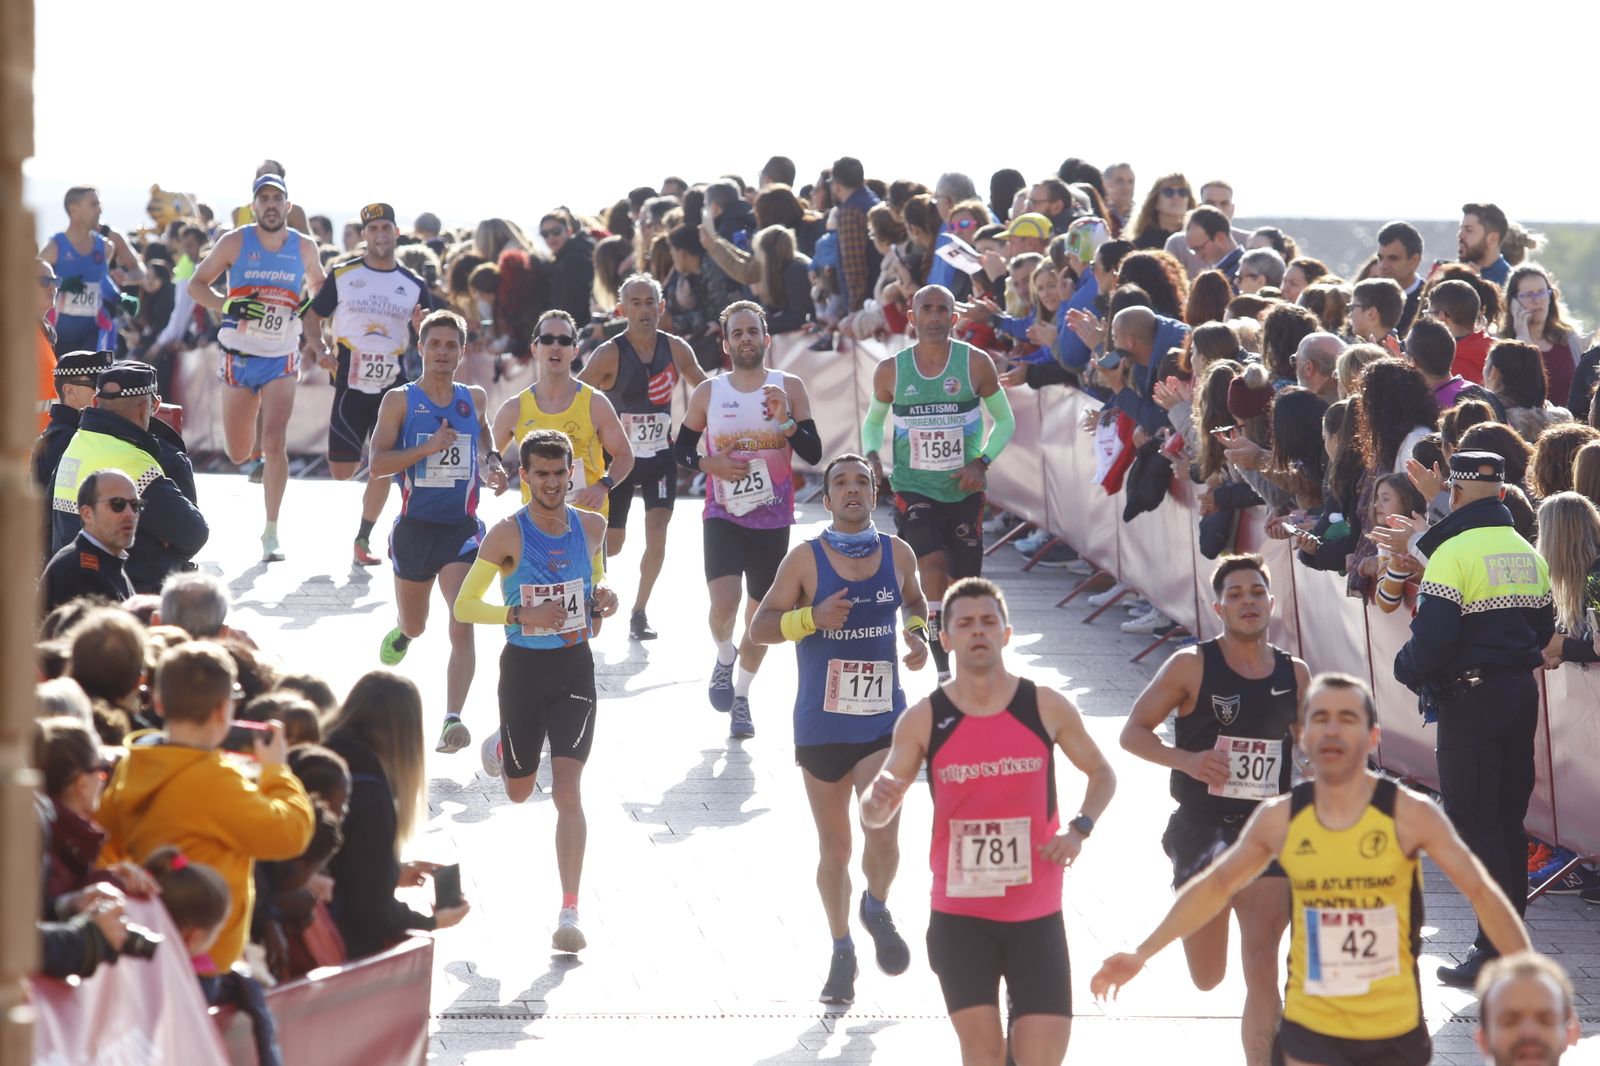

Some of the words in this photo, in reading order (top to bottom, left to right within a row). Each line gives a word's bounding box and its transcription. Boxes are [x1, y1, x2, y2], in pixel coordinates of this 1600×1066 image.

[244, 269, 297, 282] enerplus
[72, 292, 95, 305] 206
[365, 362, 394, 379] 297
[909, 403, 958, 415] ATLETISMO
[904, 415, 967, 427] TORREMOLINOS
[638, 423, 663, 441] 379
[439, 447, 461, 466] 28
[922, 439, 962, 459] 1584
[732, 472, 764, 496] 225
[543, 593, 578, 615] 14
[823, 624, 893, 641] TROTASIERRA
[849, 674, 884, 698] 171
[1236, 754, 1277, 781] 307
[972, 837, 1019, 866] 781
[1321, 876, 1396, 890] ATLETISMO
[1341, 930, 1377, 959] 42
